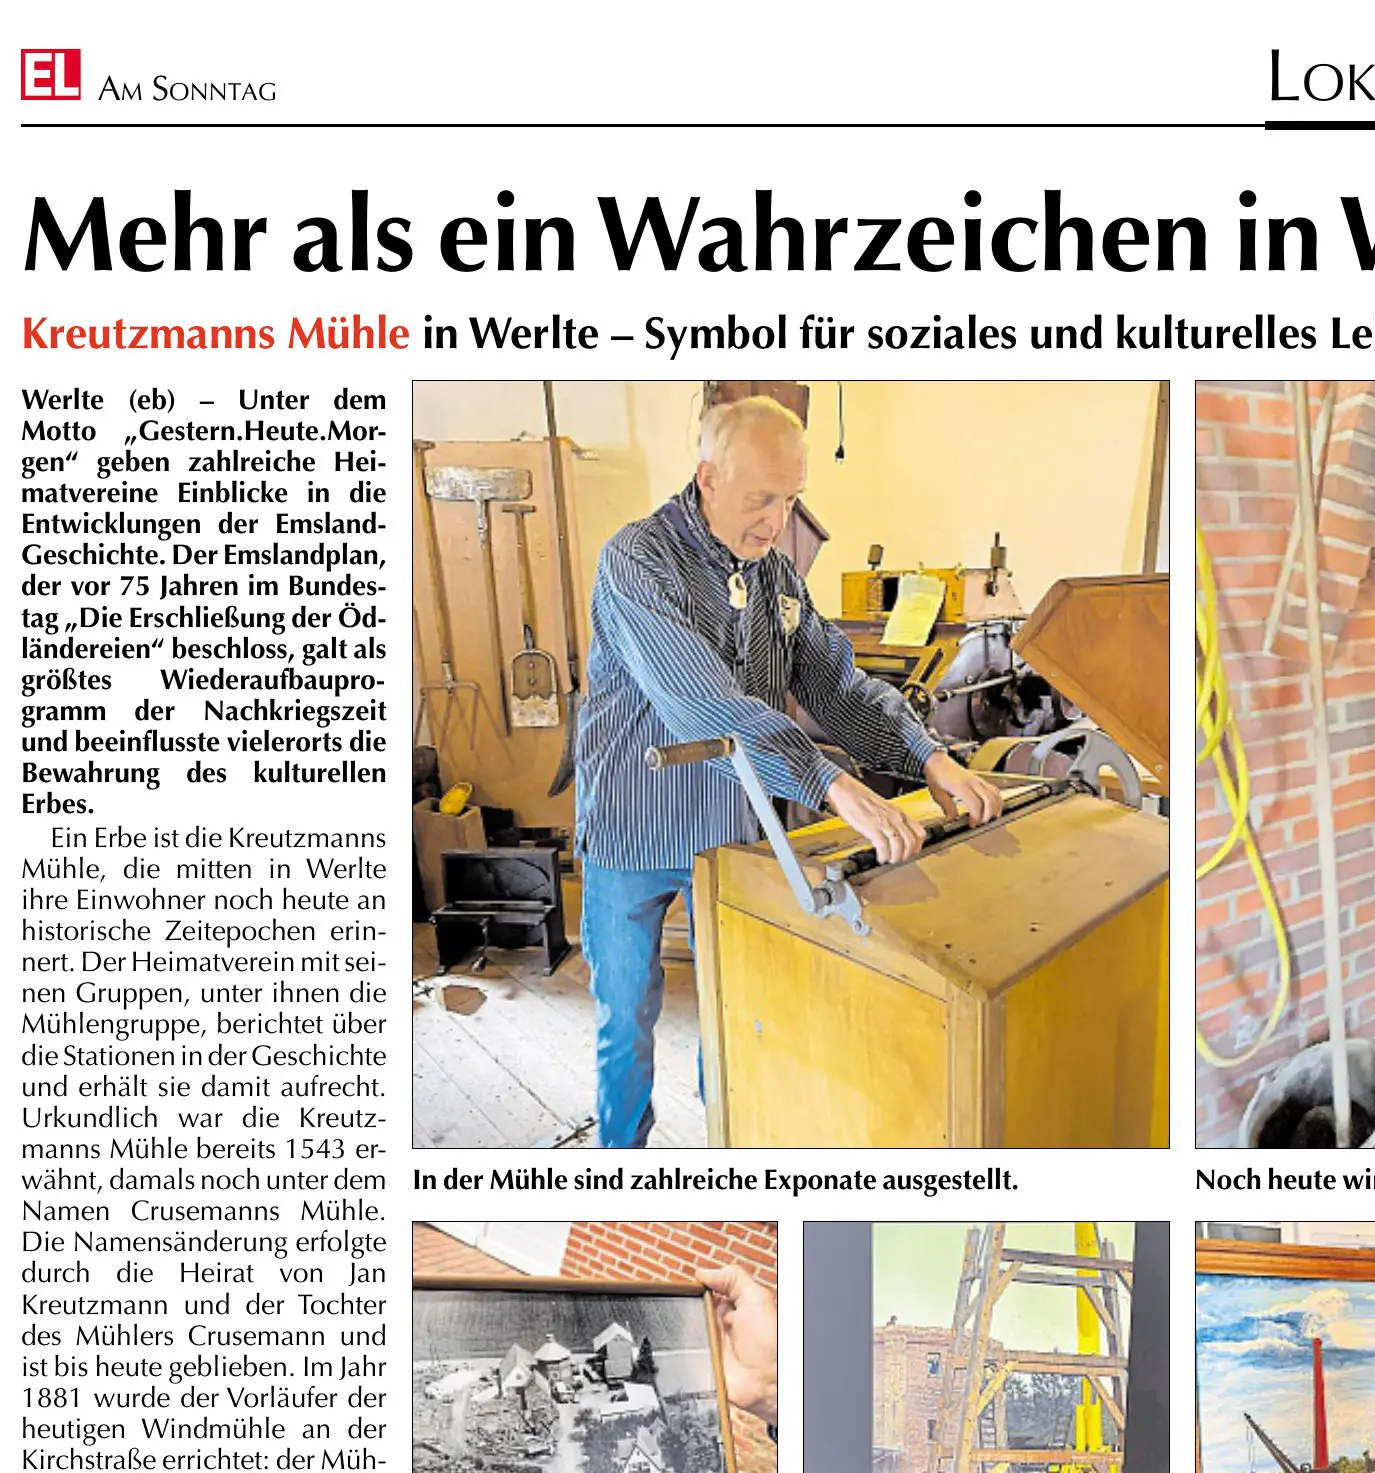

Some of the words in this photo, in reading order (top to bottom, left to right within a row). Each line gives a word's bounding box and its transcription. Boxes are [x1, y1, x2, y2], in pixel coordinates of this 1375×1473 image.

[25, 54, 80, 98] EL
[24, 189, 268, 273] Mehr
[292, 189, 414, 273] als
[439, 189, 575, 273] ein
[596, 189, 1207, 273] Wahrzeichen
[1238, 189, 1318, 272] in
[23, 316, 275, 350] Kreutzmanns
[288, 313, 410, 350] Mühle
[424, 314, 458, 349] in
[468, 313, 599, 350] Werlte
[645, 313, 787, 361] Symbol
[799, 313, 855, 350] für
[867, 313, 1017, 350] soziales
[1030, 313, 1103, 350] und
[1116, 313, 1317, 350] kulturelles
[21, 420, 97, 442] Motto
[124, 419, 387, 446] „Gestern.Heute.Mor-
[22, 511, 201, 542] Entwicklungen
[218, 511, 259, 535] der
[276, 511, 387, 535] Emsland-
[21, 542, 166, 566] Geschichte.
[172, 543, 219, 566] Der
[224, 542, 386, 573] Emslandplan,
[413, 1168, 437, 1190] In
[443, 1167, 484, 1191] der
[489, 1167, 568, 1191] Mühle
[574, 1167, 624, 1191] sind
[629, 1167, 758, 1191] zahlreiche
[764, 1168, 877, 1198] Exponate
[882, 1167, 1019, 1198] ausgestellt.
[1196, 1167, 1261, 1191] Noch
[1268, 1167, 1337, 1191] heute
